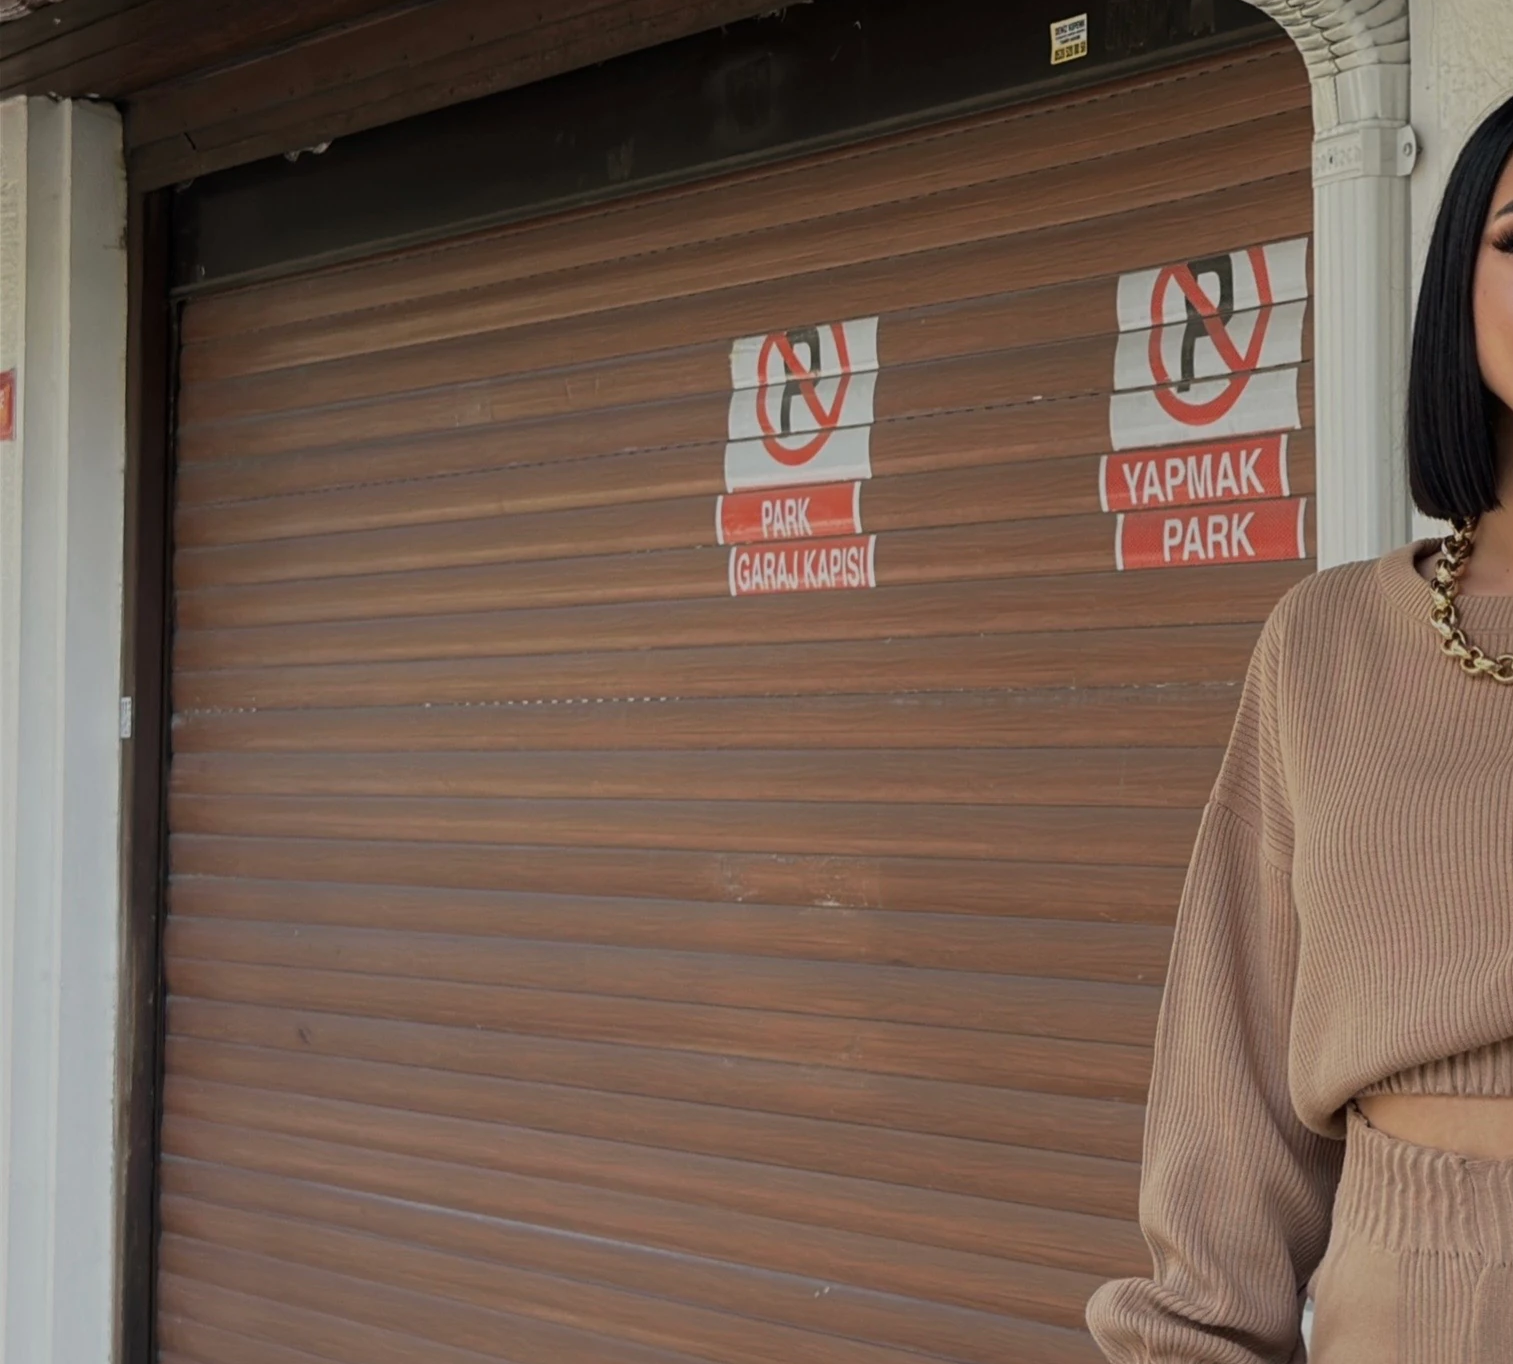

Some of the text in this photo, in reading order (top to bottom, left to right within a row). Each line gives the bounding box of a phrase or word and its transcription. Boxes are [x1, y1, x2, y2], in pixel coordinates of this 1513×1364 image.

[1121, 447, 1265, 506] YAPMAK
[761, 497, 813, 539] PARK
[1163, 511, 1255, 563] PARK
[737, 545, 867, 592] GARAJ KAPISI
